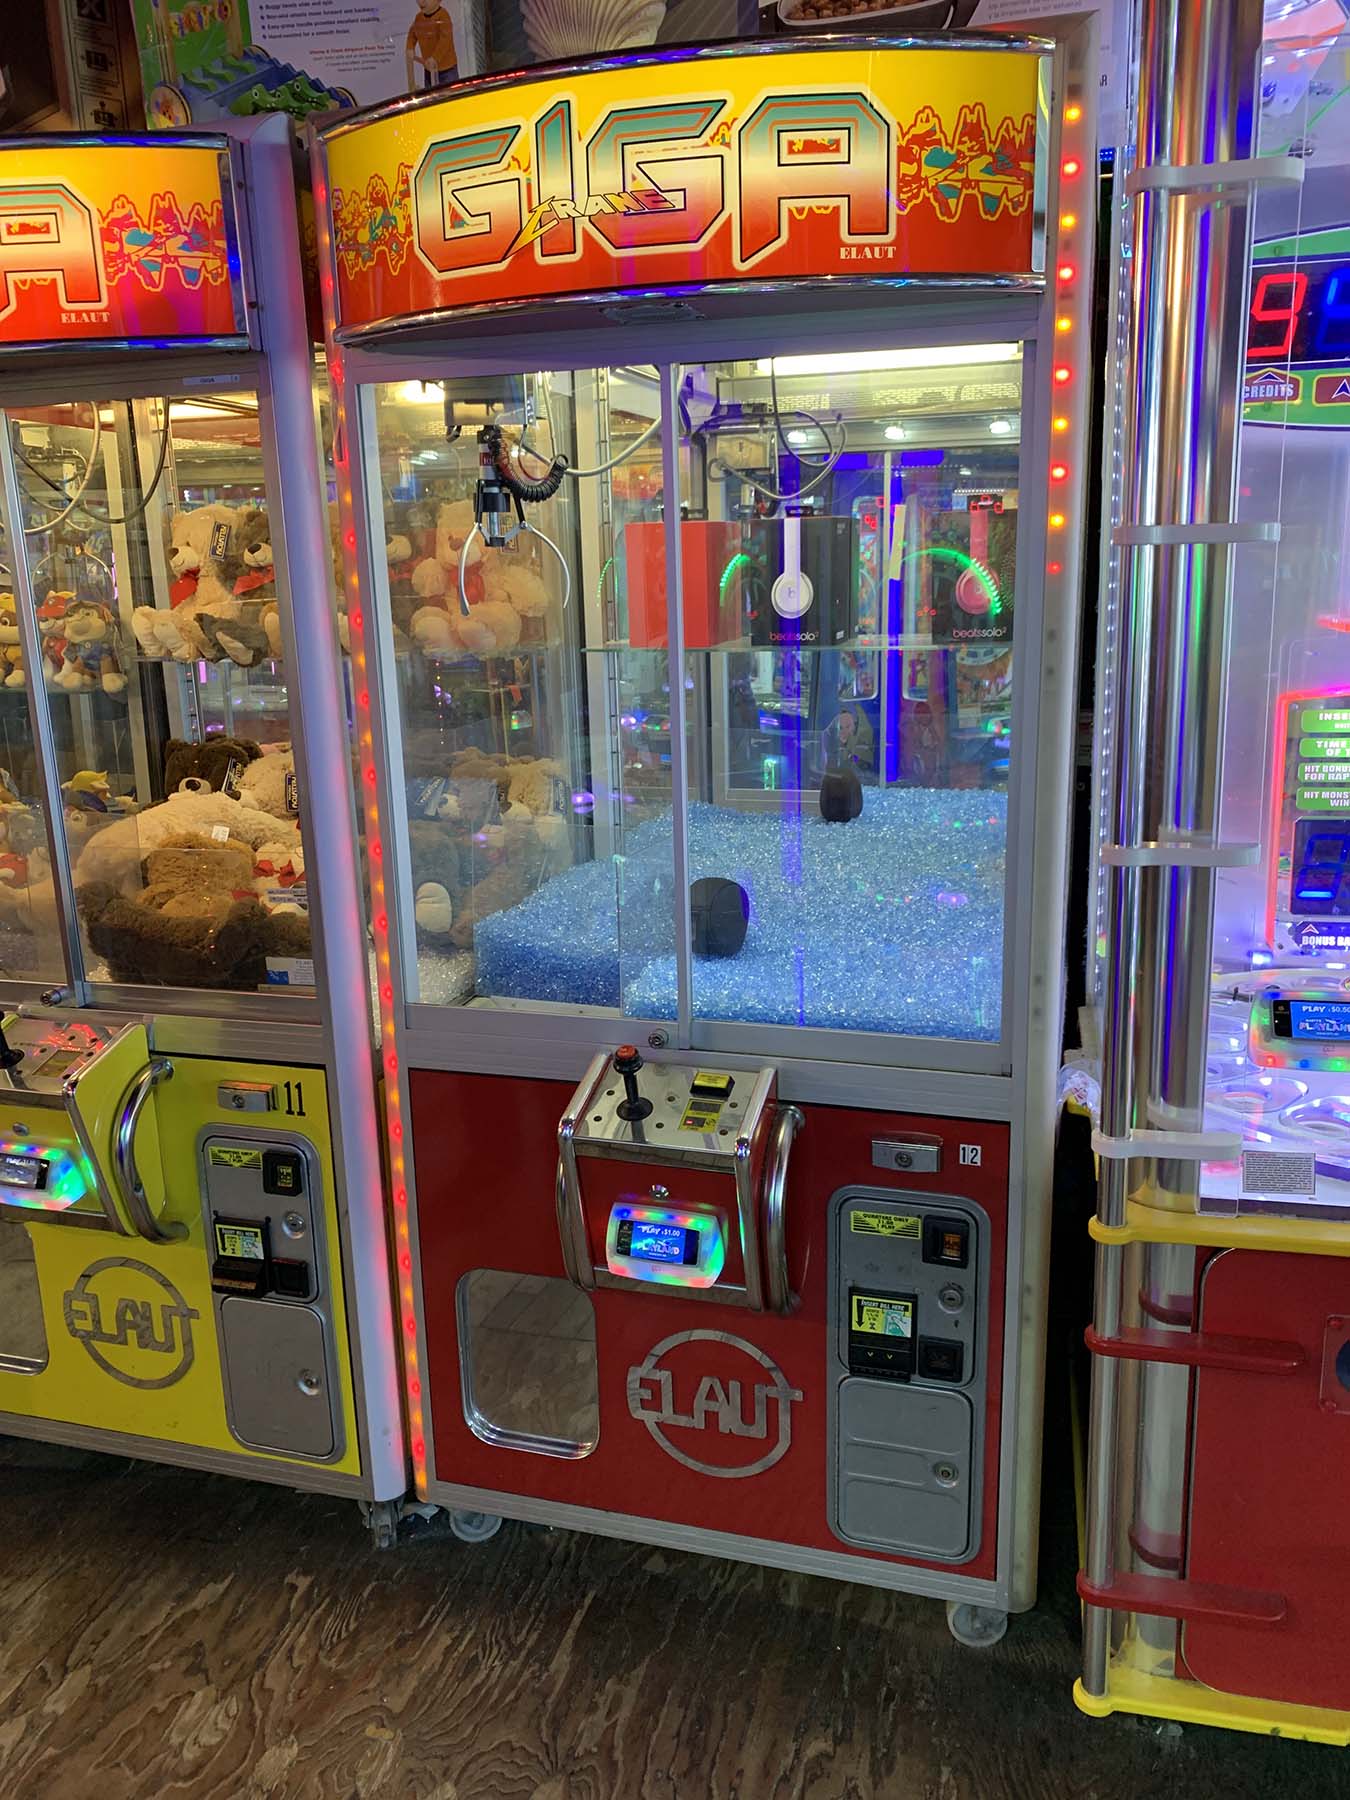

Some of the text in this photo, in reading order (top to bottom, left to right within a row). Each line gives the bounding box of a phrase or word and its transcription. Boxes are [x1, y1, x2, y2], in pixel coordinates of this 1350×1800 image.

[413, 90, 892, 276] GIGA
[839, 245, 897, 261] ELAUT
[61, 312, 110, 323] ELAUT
[1241, 383, 1294, 399] CREDITS
[1316, 741, 1347, 749] TIME
[1326, 749, 1342, 757] OF
[1304, 765, 1320, 773] HIT
[1304, 773, 1325, 781] FOR
[1303, 791, 1319, 799] HIT
[1302, 935, 1336, 946] BONUS
[284, 1080, 306, 1117] 11
[961, 1145, 979, 1165] 12
[638, 1225, 681, 1237] PLAY $1.00
[64, 1290, 199, 1354] ELAUT
[627, 1366, 803, 1439] ELAUT
